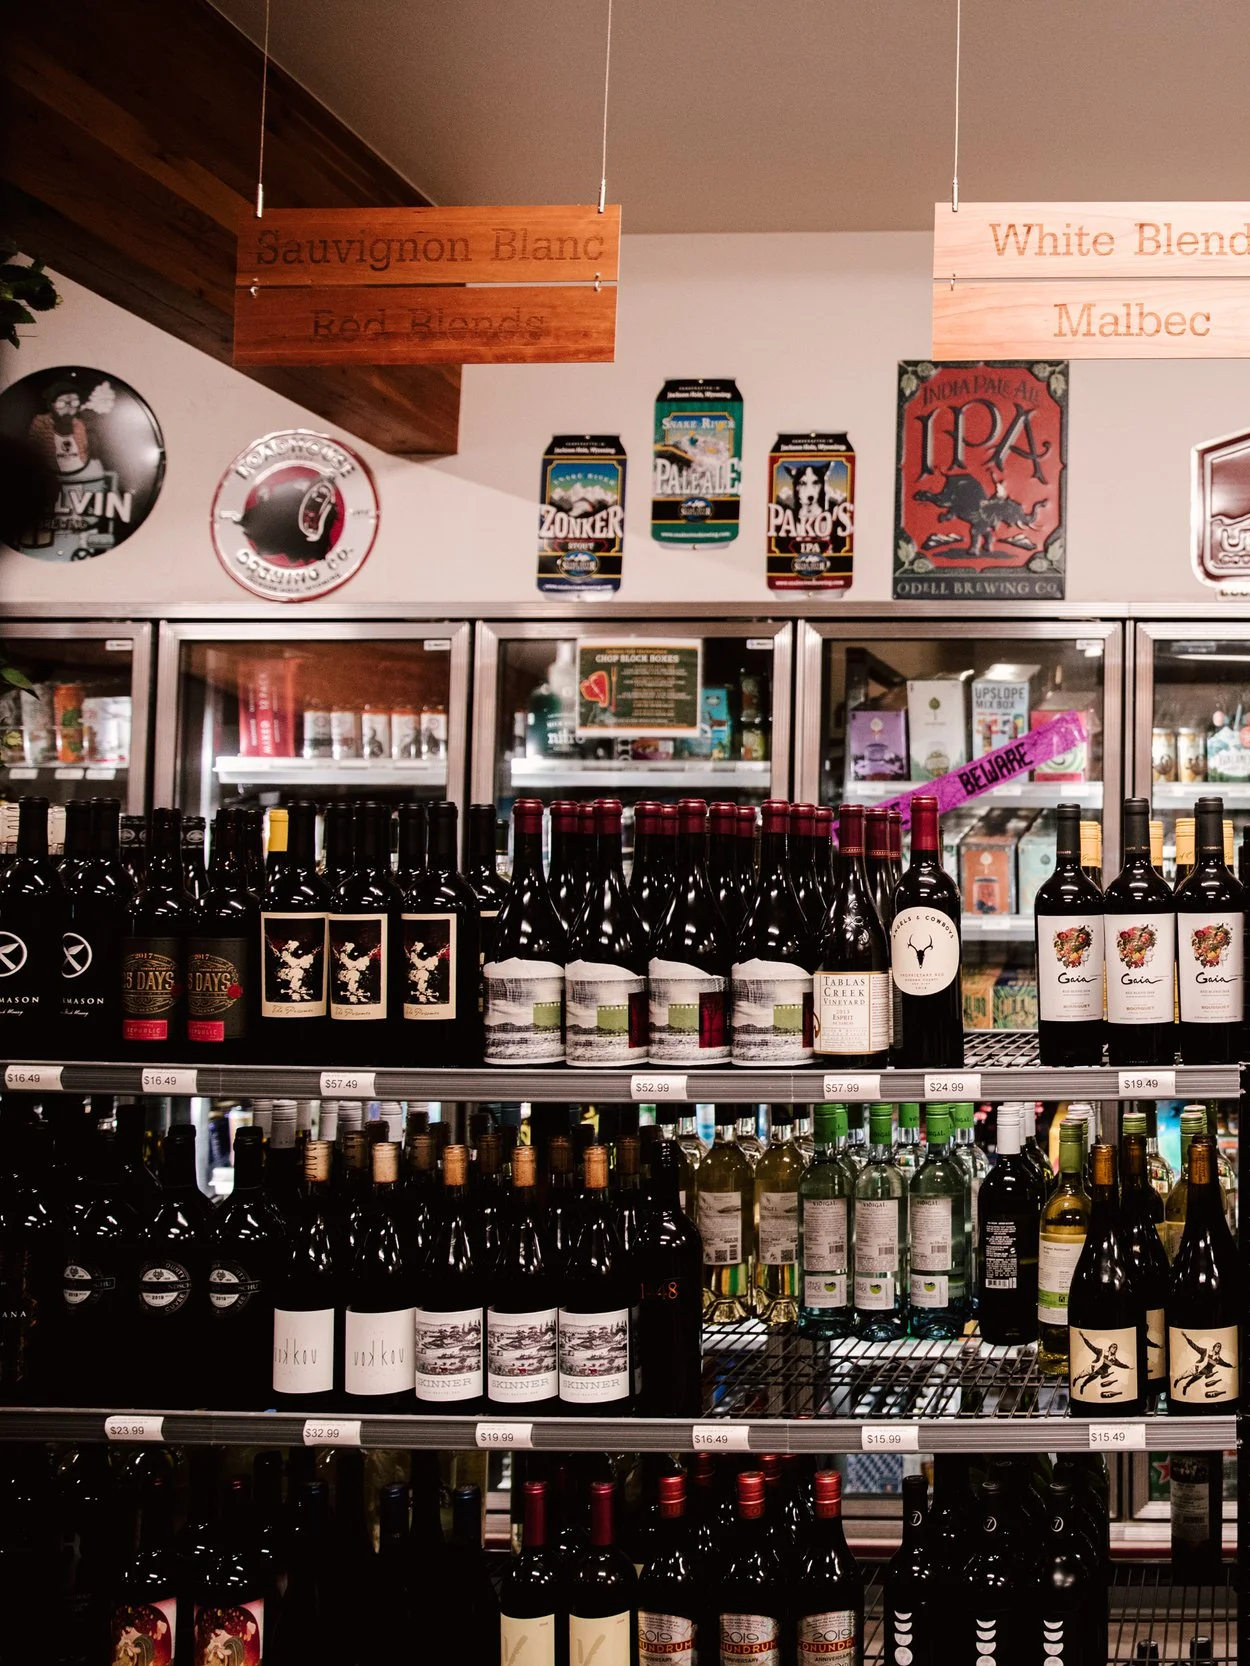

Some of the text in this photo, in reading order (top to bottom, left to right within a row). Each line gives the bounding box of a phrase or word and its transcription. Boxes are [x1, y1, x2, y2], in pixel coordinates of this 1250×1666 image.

[988, 222, 1115, 257] White
[255, 227, 605, 272] Sauvignon Blanc
[308, 306, 546, 344] Red Blends
[1053, 302, 1212, 338] Malbec
[922, 374, 1041, 409] INDIA PALE ALE
[914, 398, 1052, 485] IPA
[654, 456, 743, 495] PALE ALE
[538, 503, 624, 539] ZONKER
[766, 502, 855, 538] PAKO'S
[567, 541, 595, 550] STOUT
[800, 542, 821, 553] IPA
[896, 581, 1030, 596] ODELL BREWING
[974, 686, 1026, 700] UPSLOPE
[975, 700, 994, 709] MIX
[957, 741, 1035, 797] BEWARE
[892, 914, 955, 940] ANGELS COWBOYS
[137, 971, 175, 990] DAYS
[195, 972, 231, 992] DAYS
[823, 976, 866, 986] TABLAS
[1057, 971, 1099, 985] Gaia
[1120, 972, 1164, 986] Gaia
[1195, 971, 1238, 986] Gaia
[823, 987, 865, 997] CREEK
[823, 997, 866, 1006] VINEYARD
[7, 1072, 41, 1084] $16.49
[143, 1074, 177, 1086] $16.49
[324, 1079, 358, 1090] $57.49
[1123, 1078, 1159, 1090] $19.49
[635, 1082, 670, 1093] $52.99
[825, 1083, 860, 1094] $57.99
[929, 1082, 964, 1093] $24.99
[417, 1377, 473, 1389] SKINNER
[491, 1378, 550, 1390] SKINNER
[562, 1378, 622, 1391] SKINNER
[109, 1425, 145, 1436] $23.99
[304, 1428, 340, 1439] $32.99
[480, 1431, 515, 1443] $19.99
[1090, 1431, 1126, 1442] $15.49
[693, 1434, 729, 1445] $16.49
[866, 1434, 902, 1445] $15.99
[638, 1630, 673, 1643] 2019
[721, 1630, 760, 1644] 2019
[812, 1628, 853, 1643] 2019
